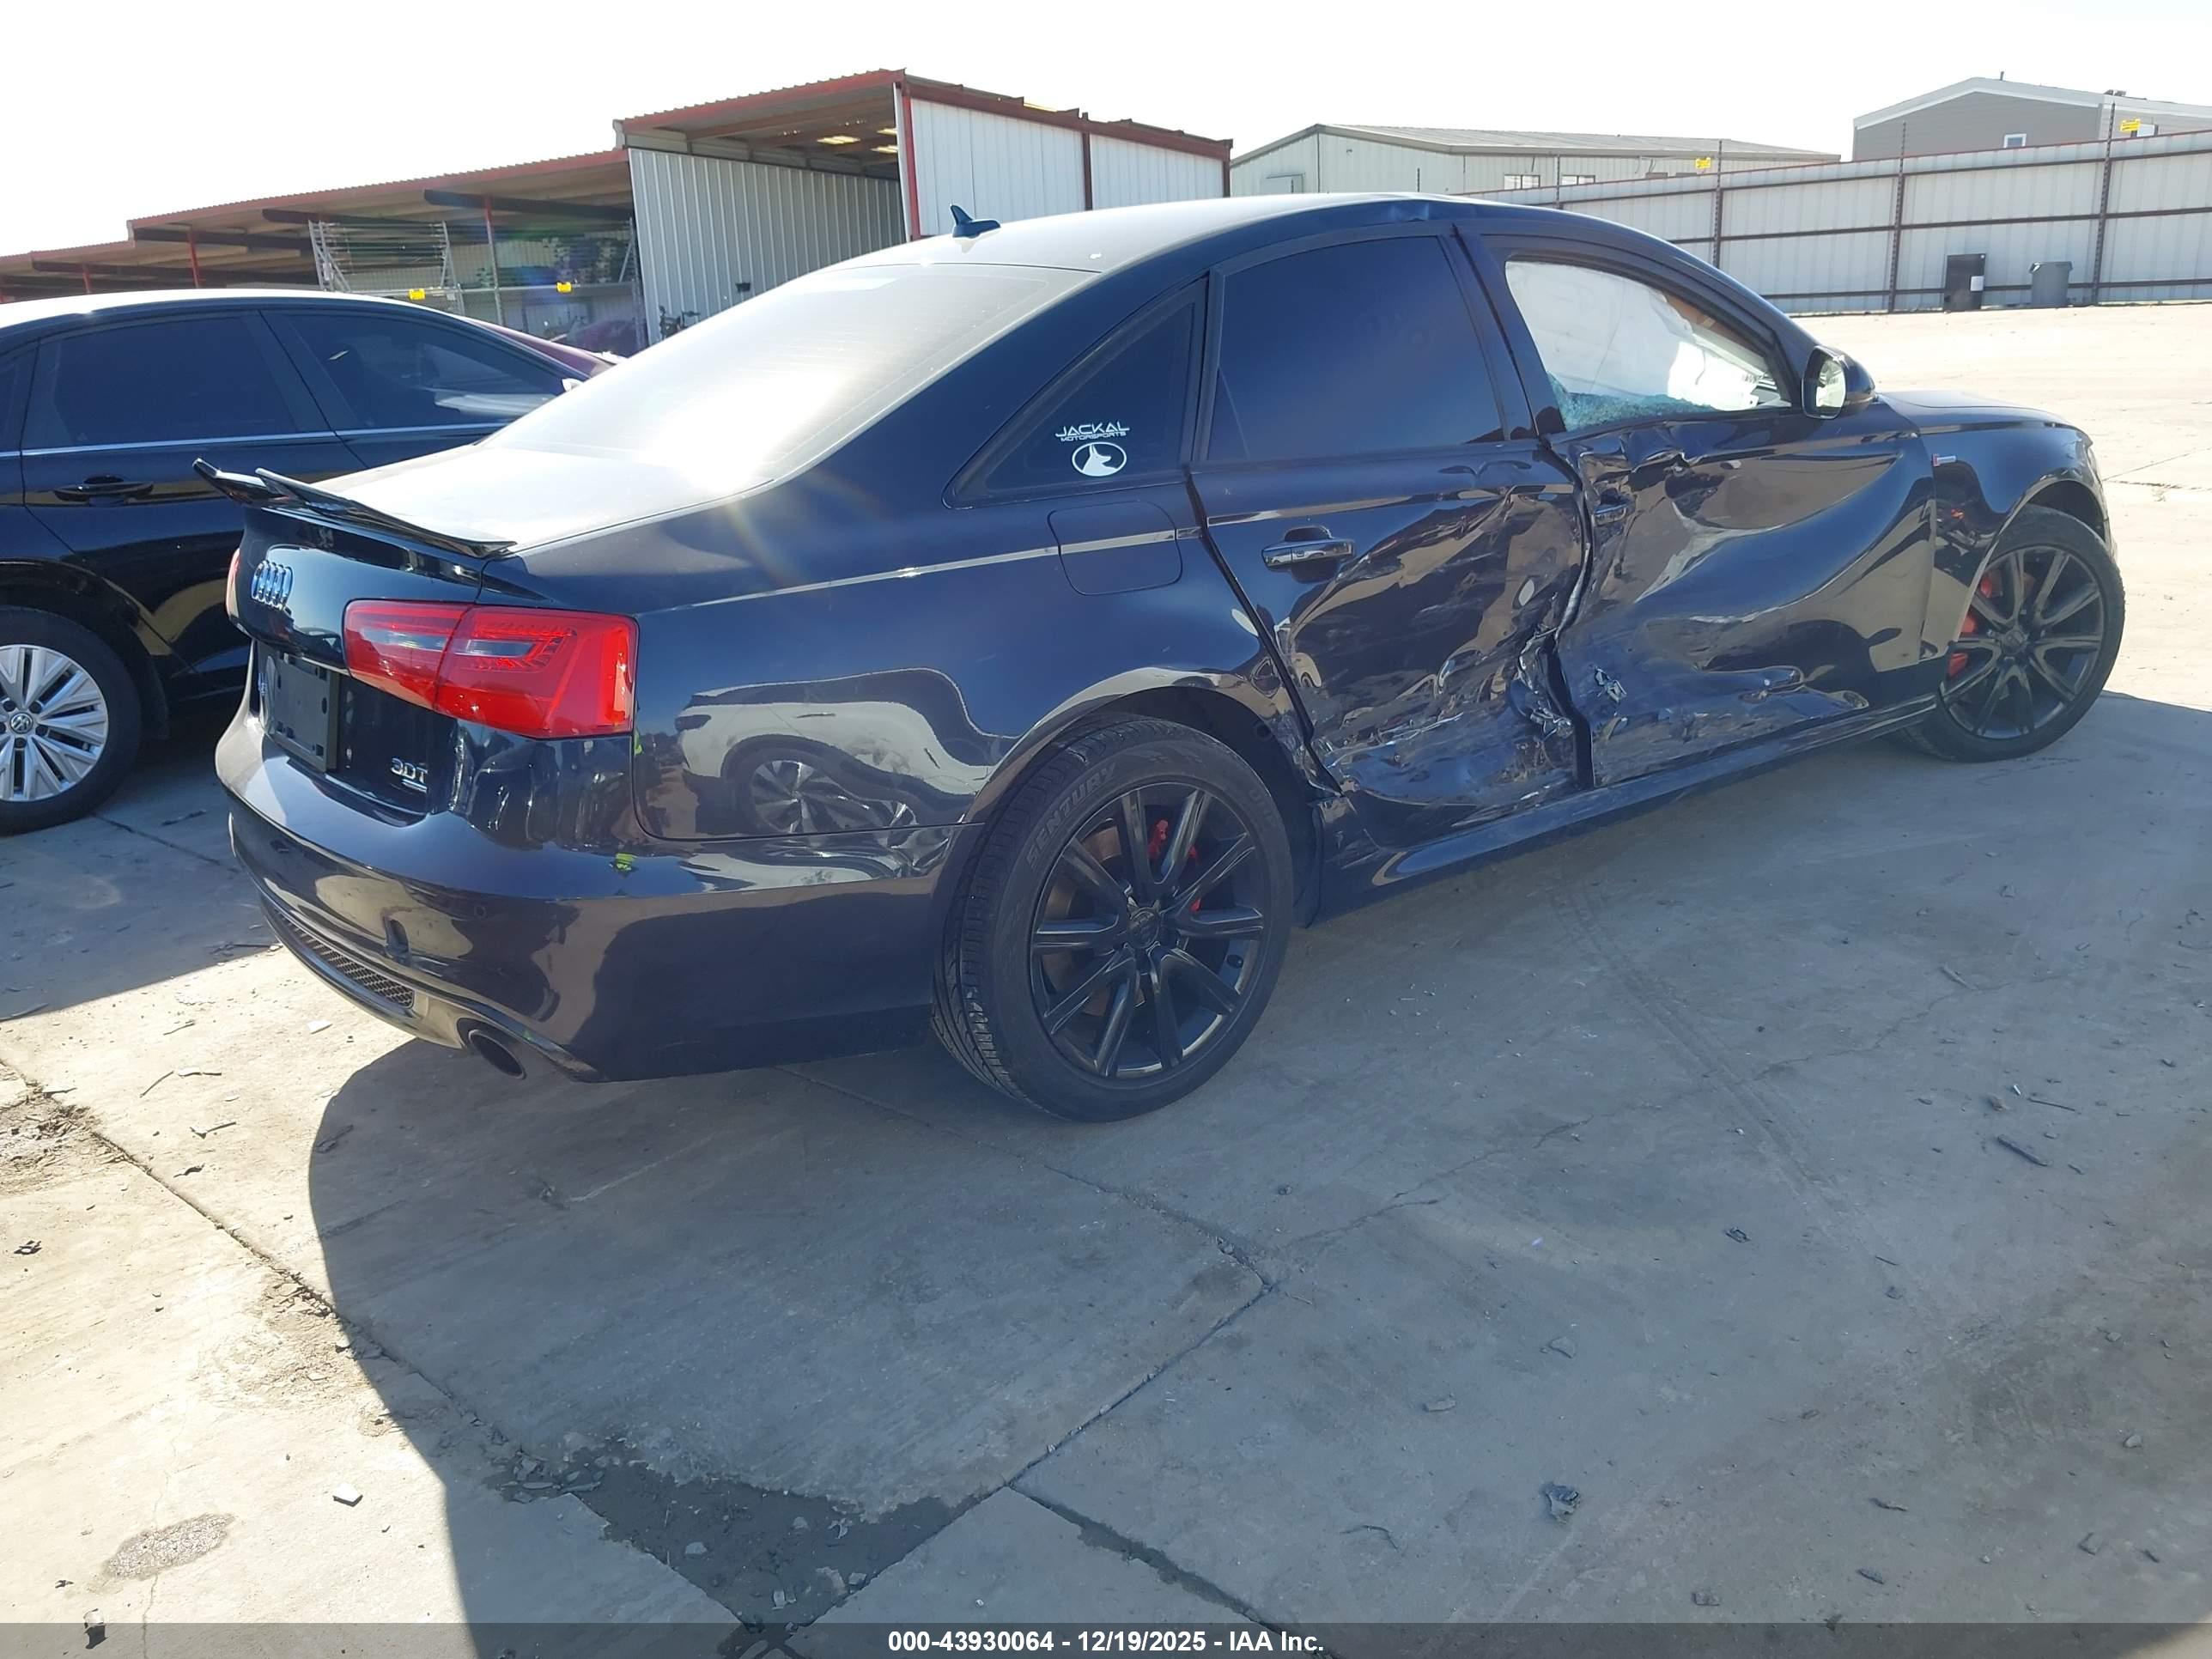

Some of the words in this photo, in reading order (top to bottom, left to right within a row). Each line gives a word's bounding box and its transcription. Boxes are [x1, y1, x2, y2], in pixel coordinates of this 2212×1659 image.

[1055, 421, 1130, 437] JACKAL
[1060, 431, 1127, 442] MOTORSPORTS
[1026, 762, 1116, 869] SENTURY
